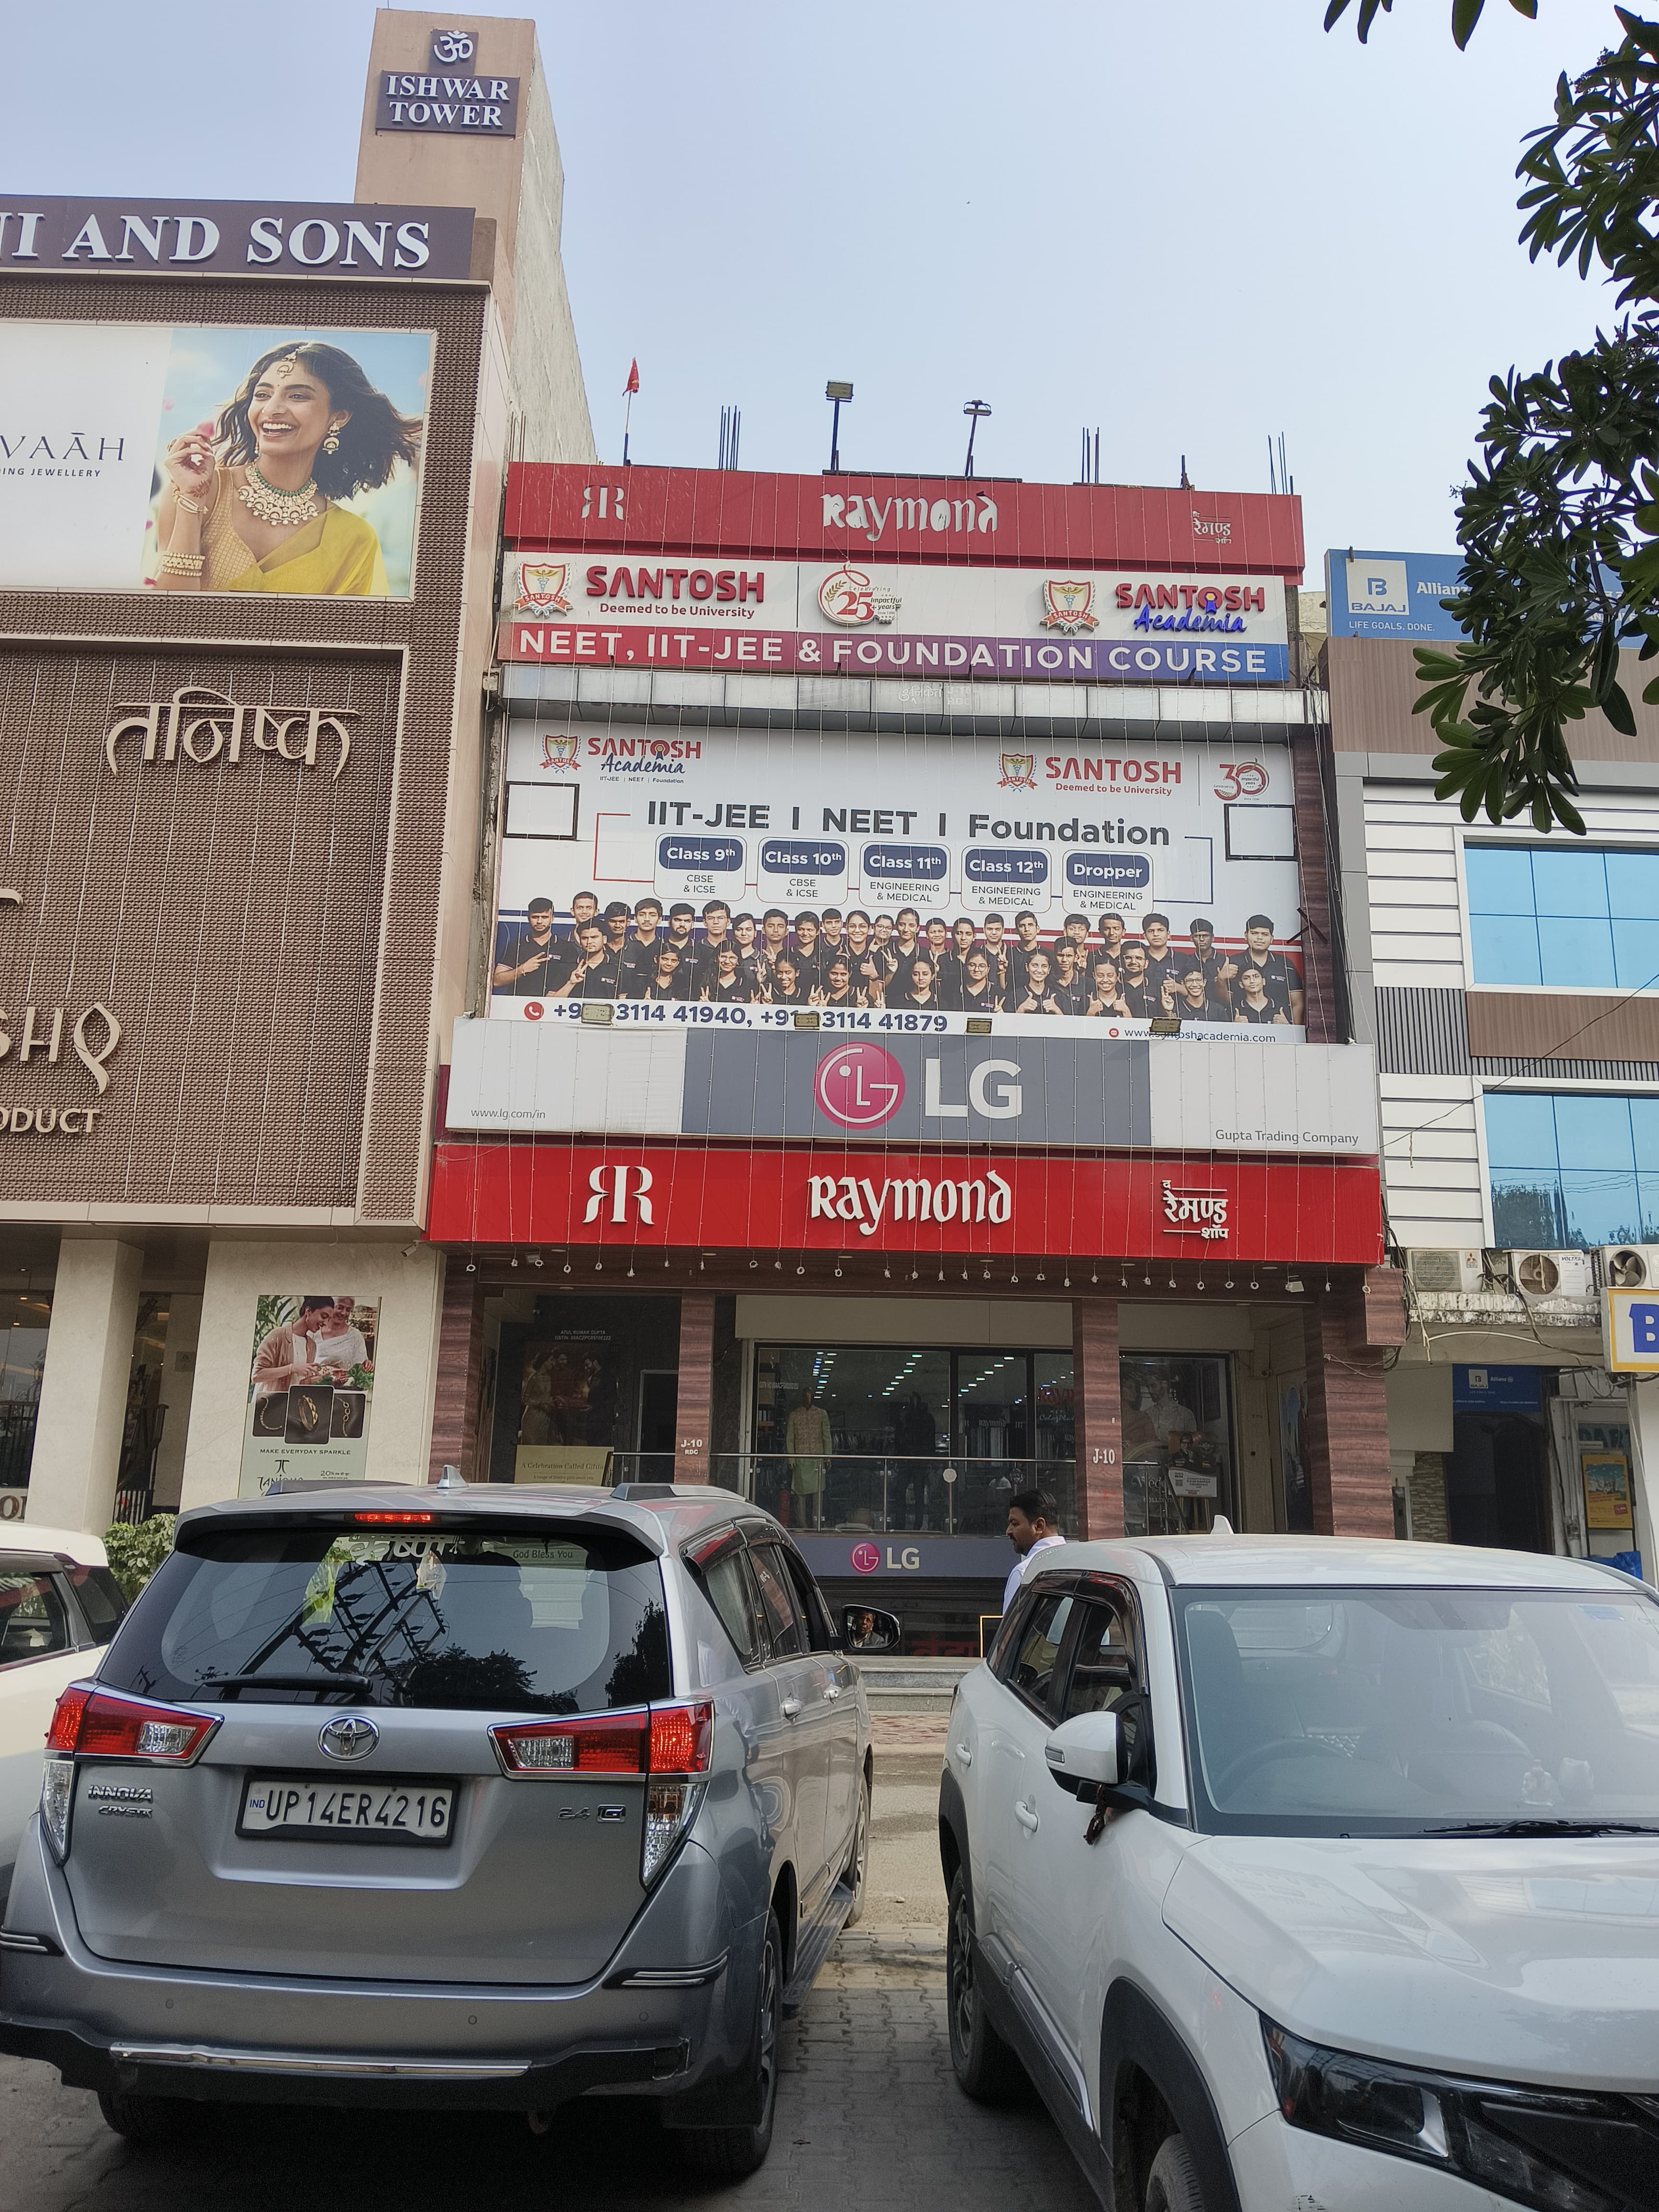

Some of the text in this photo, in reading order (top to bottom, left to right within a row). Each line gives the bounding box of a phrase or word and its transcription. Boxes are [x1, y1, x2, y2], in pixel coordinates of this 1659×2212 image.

[386, 74, 510, 100] ISHWAR
[389, 102, 503, 127] TOWER
[0, 212, 430, 269] I AND SONS
[31, 469, 101, 477] JEWELLERY
[587, 565, 764, 602] SANTOSH
[1416, 582, 1469, 595] Allianz
[524, 594, 563, 604] SANTOSH
[1116, 582, 1265, 612] SANTOSH
[600, 603, 755, 620] Deemed to be University
[837, 591, 874, 620] 25
[1351, 603, 1406, 613] BAJAJ
[1053, 612, 1089, 620] SANTOSH
[1134, 604, 1248, 633] Academia
[1349, 621, 1435, 632] LIFE GOALS. DONE.
[521, 629, 1266, 673] NEET, IIT-JEE & FOUNDATION COURSE
[588, 737, 701, 759] SANTOSH
[601, 752, 686, 774] Academia
[1046, 757, 1181, 784] SANTOSH
[1056, 782, 1172, 796] Deemed to be University
[1214, 762, 1267, 801] 30
[648, 801, 770, 829] IIT-JEE
[823, 808, 917, 835] NEET
[969, 814, 1170, 846] Foundation
[667, 847, 736, 861] Class 9th
[765, 850, 842, 866] Class 10th
[869, 854, 941, 870] Class 11th
[969, 859, 1044, 874] Class 12th
[686, 875, 714, 883] CBSE
[1074, 863, 1143, 880] Dropper
[684, 885, 716, 894] & ICSE
[789, 878, 817, 887] CBSE
[870, 882, 939, 892] ENGINEERING
[795, 889, 818, 898] ICSE
[877, 892, 932, 902] & MEDICAL
[972, 886, 1041, 896] ENGINEERING
[1073, 890, 1143, 900] ENGINEERING
[979, 897, 1034, 906] & MEDICAL
[1090, 902, 1136, 910] MEDICAL
[673, 1005, 753, 1028] 41940,
[878, 1013, 948, 1032] 41879
[925, 1058, 1022, 1119] LG
[471, 1107, 546, 1120] www.lg.com/in
[1215, 1129, 1359, 1147] Gupta Trading Company
[1163, 1190, 1229, 1224] रेमण्ड
[1201, 1224, 1230, 1239] शॉप
[681, 1439, 702, 1447] J-10
[1093, 1448, 1115, 1465] J-10
[513, 1550, 573, 1559] God Bless You
[887, 1547, 920, 1570] LG
[88, 1785, 152, 1800] INNOVA
[249, 1799, 265, 1809] IND
[266, 1790, 447, 1827] UP14ER4216
